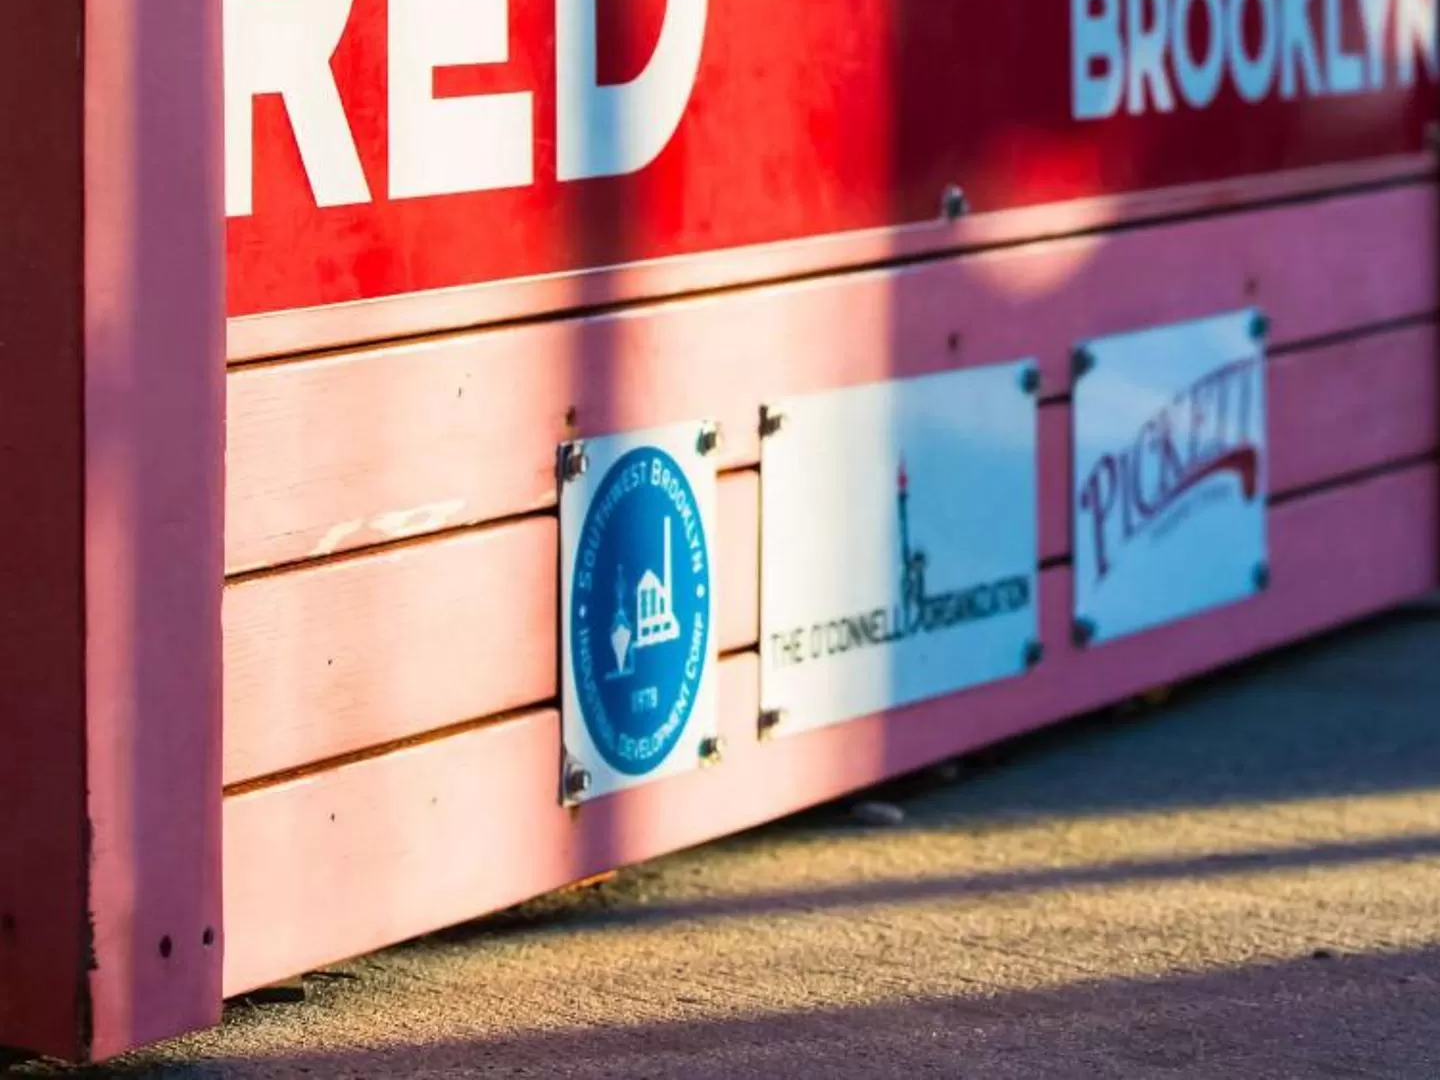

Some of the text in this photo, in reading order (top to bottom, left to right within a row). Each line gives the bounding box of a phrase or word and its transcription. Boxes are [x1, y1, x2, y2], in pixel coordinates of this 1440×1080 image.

[578, 457, 704, 592] SOUTHWEST BROOKLYN
[771, 626, 806, 666] THE
[809, 602, 906, 660] O'CONNELL
